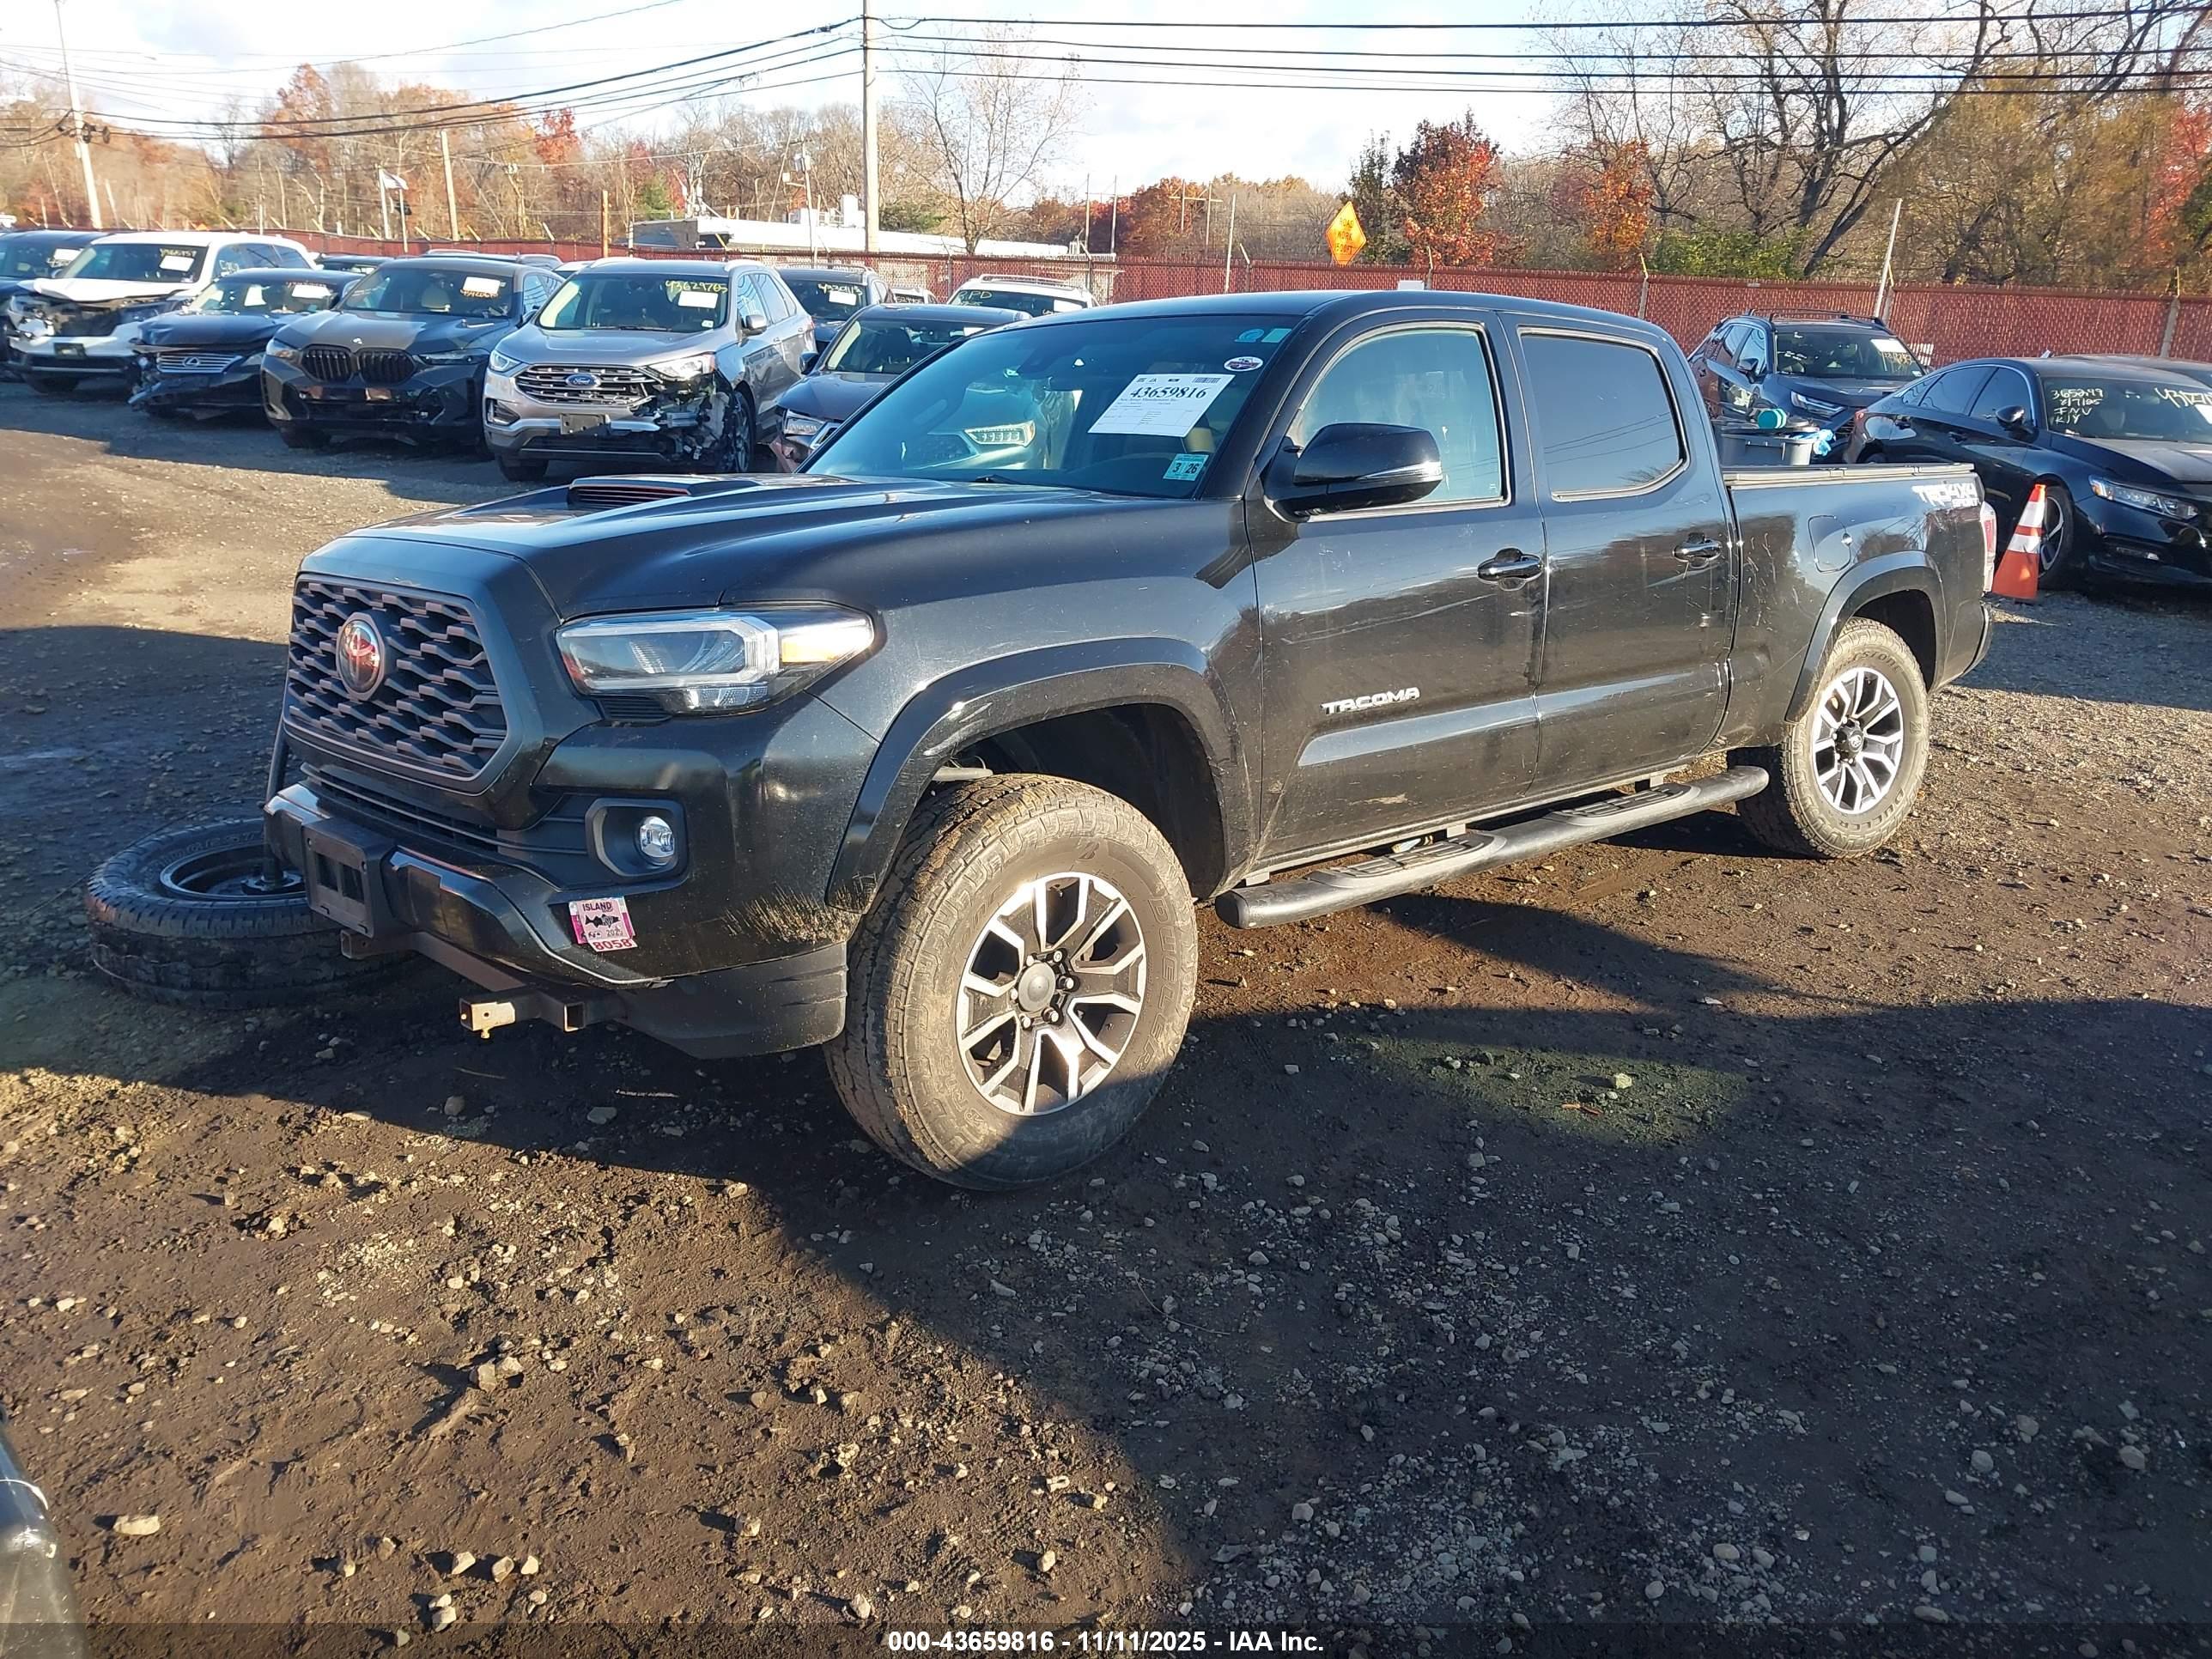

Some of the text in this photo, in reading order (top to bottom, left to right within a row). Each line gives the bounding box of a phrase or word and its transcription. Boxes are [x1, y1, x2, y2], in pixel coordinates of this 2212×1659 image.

[1337, 230, 1353, 241] WORK
[1129, 386, 1212, 399] 43659816
[1172, 462, 1200, 473] 3 26
[1321, 687, 1420, 715] TACOMA
[582, 901, 612, 912] ISLAND
[592, 939, 633, 951] 8058
[1135, 897, 1177, 1073] DUELER
